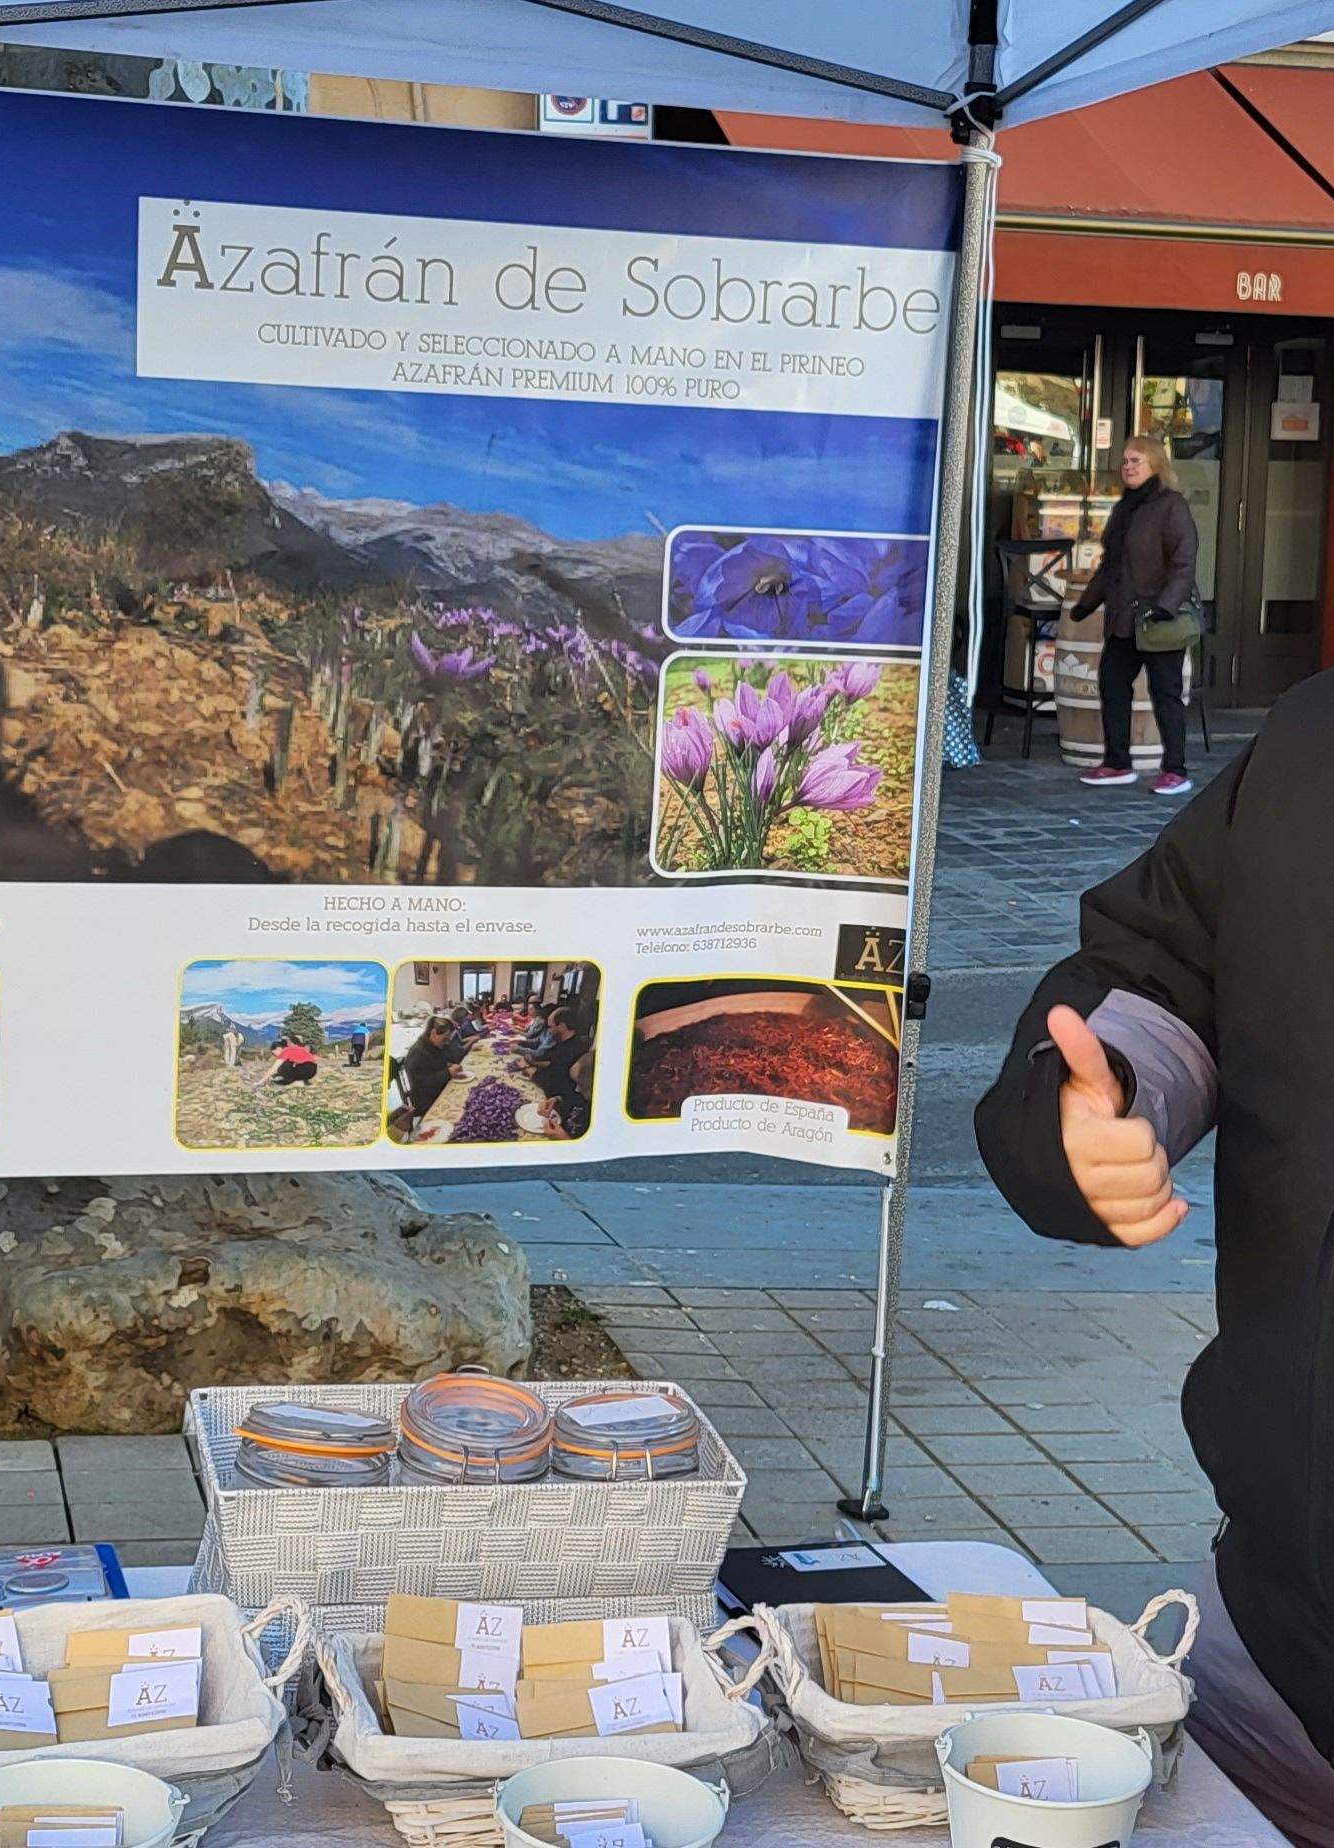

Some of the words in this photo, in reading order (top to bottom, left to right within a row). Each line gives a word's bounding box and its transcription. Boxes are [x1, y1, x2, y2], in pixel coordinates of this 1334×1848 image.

[494, 245, 588, 314] de
[622, 255, 940, 335] Sobrarbe
[1236, 271, 1282, 302] BAR
[258, 322, 388, 351] CULTIVADO
[395, 331, 411, 352] Y
[418, 333, 596, 363] SELECCIONADO
[605, 344, 622, 364] A
[630, 345, 707, 369] MANO
[714, 350, 744, 371] EN
[750, 352, 772, 372] EL
[779, 353, 866, 378] PIRINEO
[391, 361, 503, 388] AZAFRÁN
[511, 367, 613, 394] PREMIUM
[625, 374, 678, 398] 100%
[685, 377, 741, 400] PURO
[323, 896, 386, 912] HECHO
[391, 896, 403, 912] A
[407, 897, 467, 912] MANO:
[248, 916, 301, 932] Desde
[306, 917, 321, 932] la
[325, 917, 401, 936] recogida
[405, 918, 450, 934] hasta
[455, 918, 470, 934] el
[475, 921, 538, 935] envase.
[636, 921, 823, 938] www.azafrandesobrarbe.com
[692, 937, 757, 952] 638712936
[693, 1098, 754, 1113] Producto
[760, 1099, 779, 1114] de
[784, 1101, 835, 1122] España
[690, 1117, 752, 1132] Producto
[757, 1118, 776, 1133] de
[780, 1121, 833, 1143] Aragón
